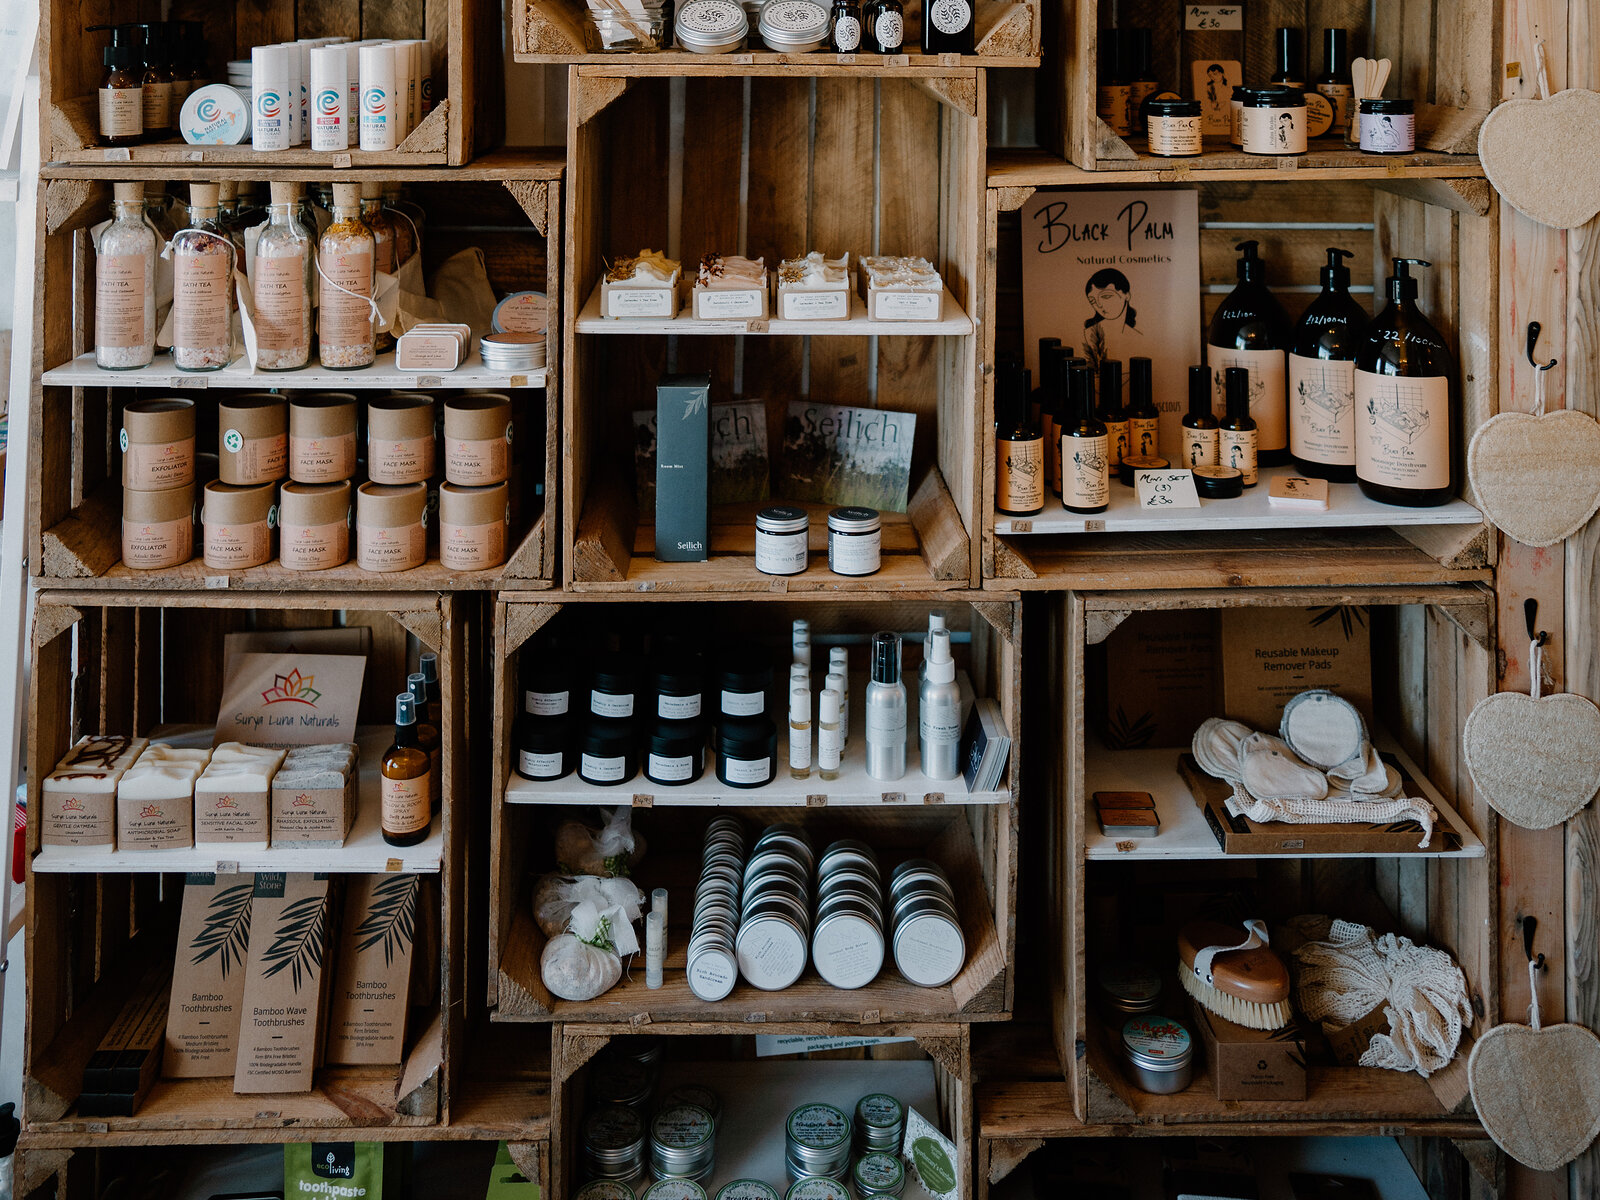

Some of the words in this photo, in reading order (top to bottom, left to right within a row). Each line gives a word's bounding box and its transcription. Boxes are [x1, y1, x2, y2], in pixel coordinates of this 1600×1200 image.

[1198, 17, 1221, 29] £30
[1076, 254, 1117, 265] Natural
[1119, 254, 1172, 264] Cosmetics
[804, 407, 899, 447] Seilich
[151, 461, 188, 473] EXFOLIATOR
[1154, 484, 1172, 493] (3)
[1147, 495, 1173, 506] £30
[130, 543, 168, 551] EXFOLIATOR
[224, 544, 243, 552] MASK
[677, 540, 703, 551] Seilich
[1255, 647, 1299, 659] Reusable
[1300, 646, 1340, 661] Makeup
[1263, 660, 1308, 671] Remover
[1308, 659, 1332, 670] Pads
[235, 712, 264, 732] Surya
[268, 713, 294, 727] Luna
[300, 712, 340, 728] Naturals
[259, 881, 282, 891] Stone
[356, 980, 388, 989] Bamboo
[192, 993, 224, 1002] Bamboo
[346, 991, 396, 1000] Toothbrushes
[181, 1004, 233, 1014] Toothbrushes
[253, 1007, 285, 1016] Bamboo
[286, 1006, 308, 1015] Wave
[253, 1017, 306, 1027] Toothbrushes
[807, 1043, 833, 1051] packaging
[844, 1040, 864, 1048] posting
[299, 1179, 367, 1198] toothpaste
